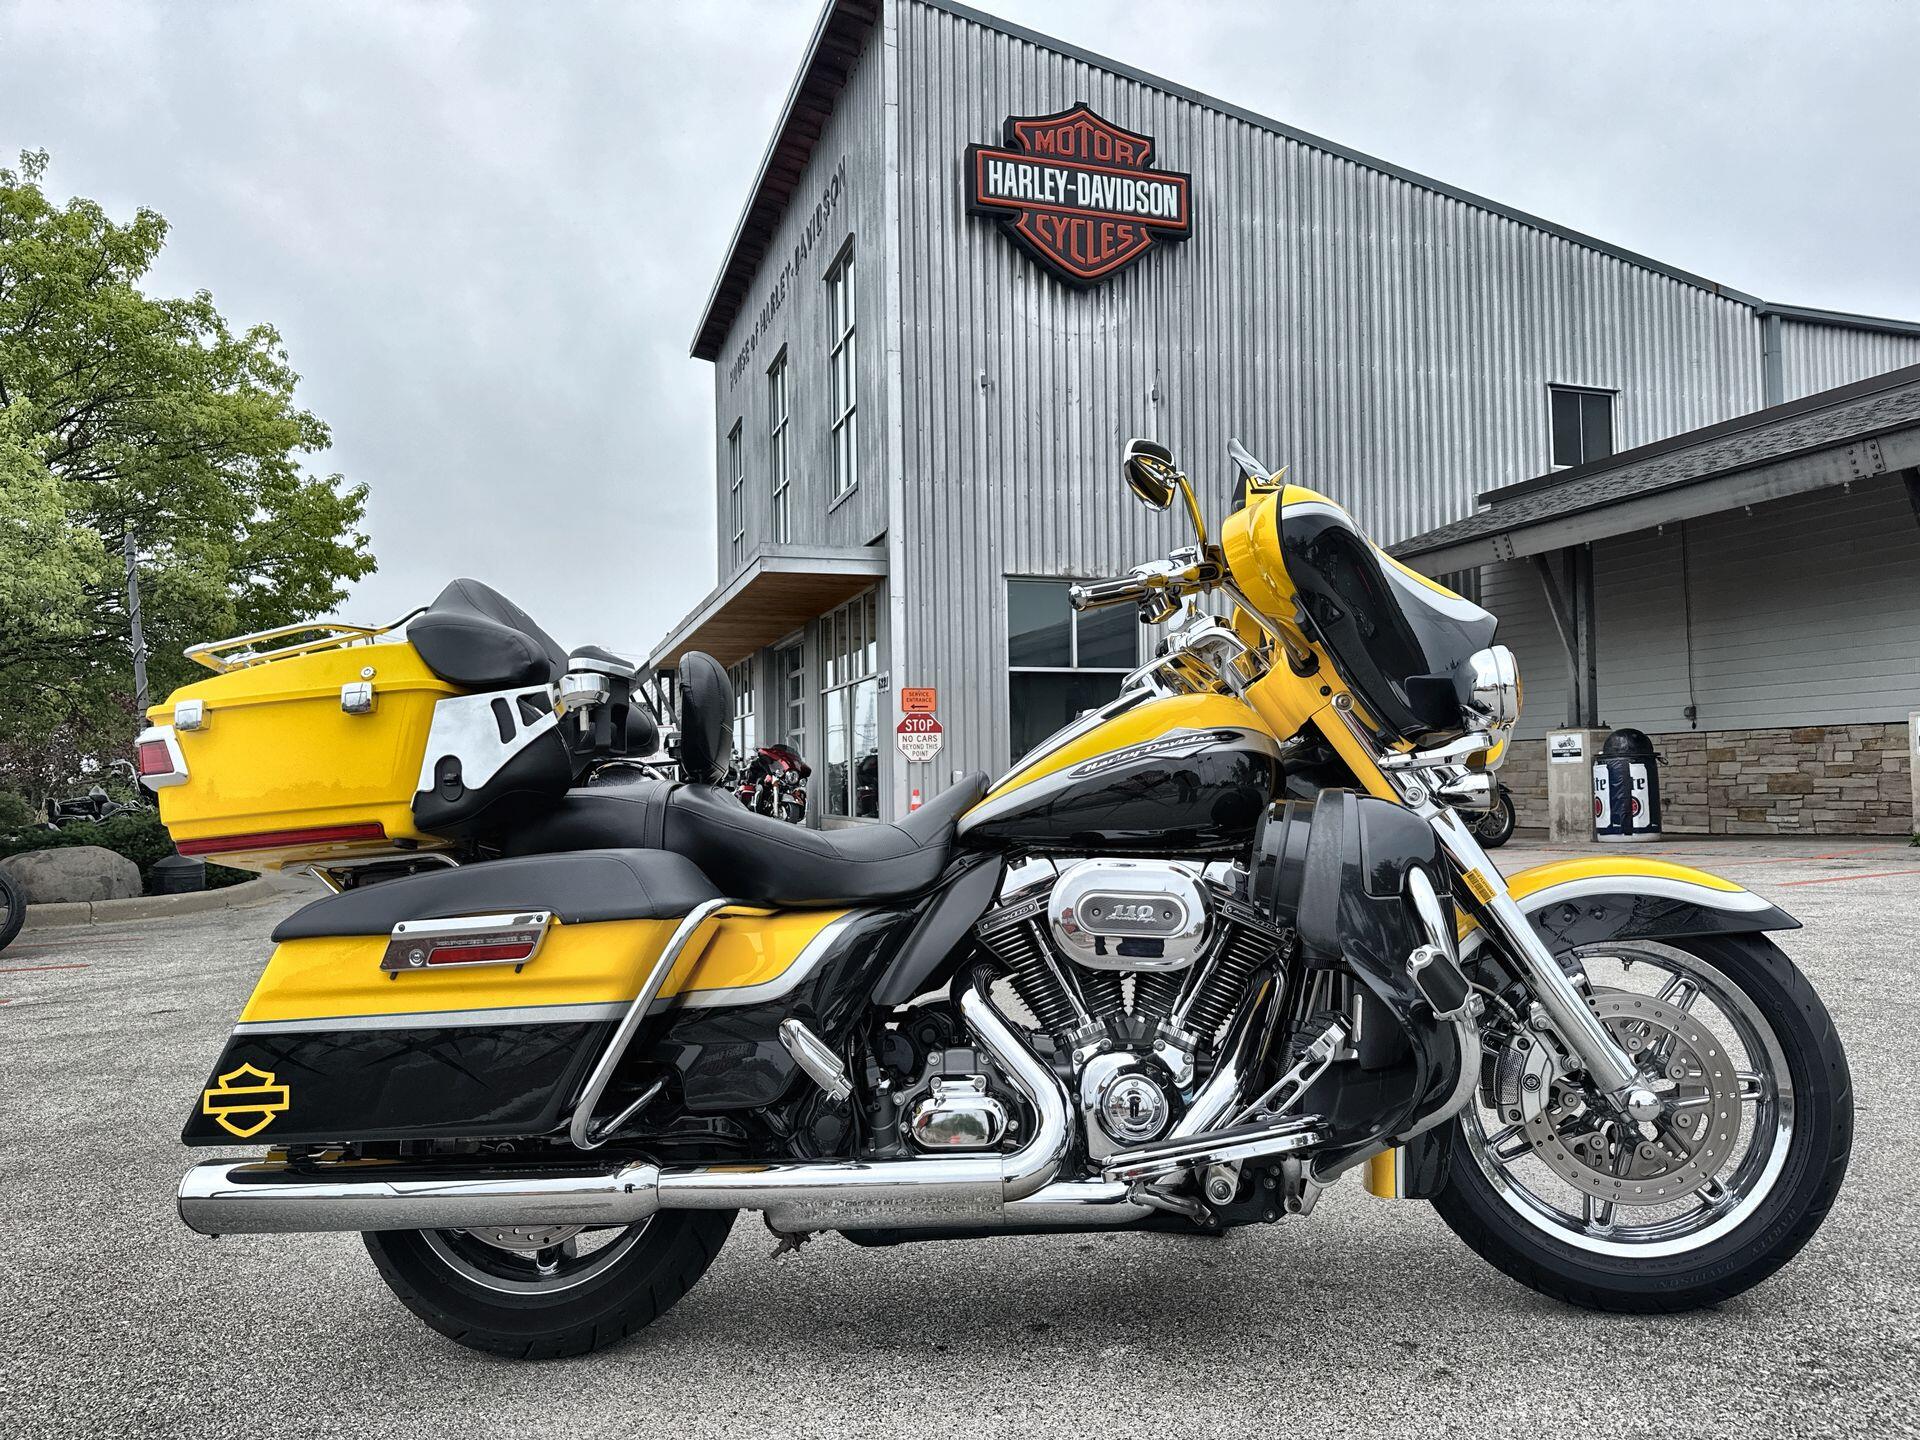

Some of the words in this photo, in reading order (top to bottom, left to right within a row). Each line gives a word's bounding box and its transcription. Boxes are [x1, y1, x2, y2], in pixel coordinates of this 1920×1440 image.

[1035, 120, 1135, 167] MOTOR
[988, 160, 1178, 219] HARLEY-DAVIDSON
[1036, 214, 1134, 266] CYCLES
[905, 719, 934, 732] STOP
[1111, 904, 1154, 918] 110
